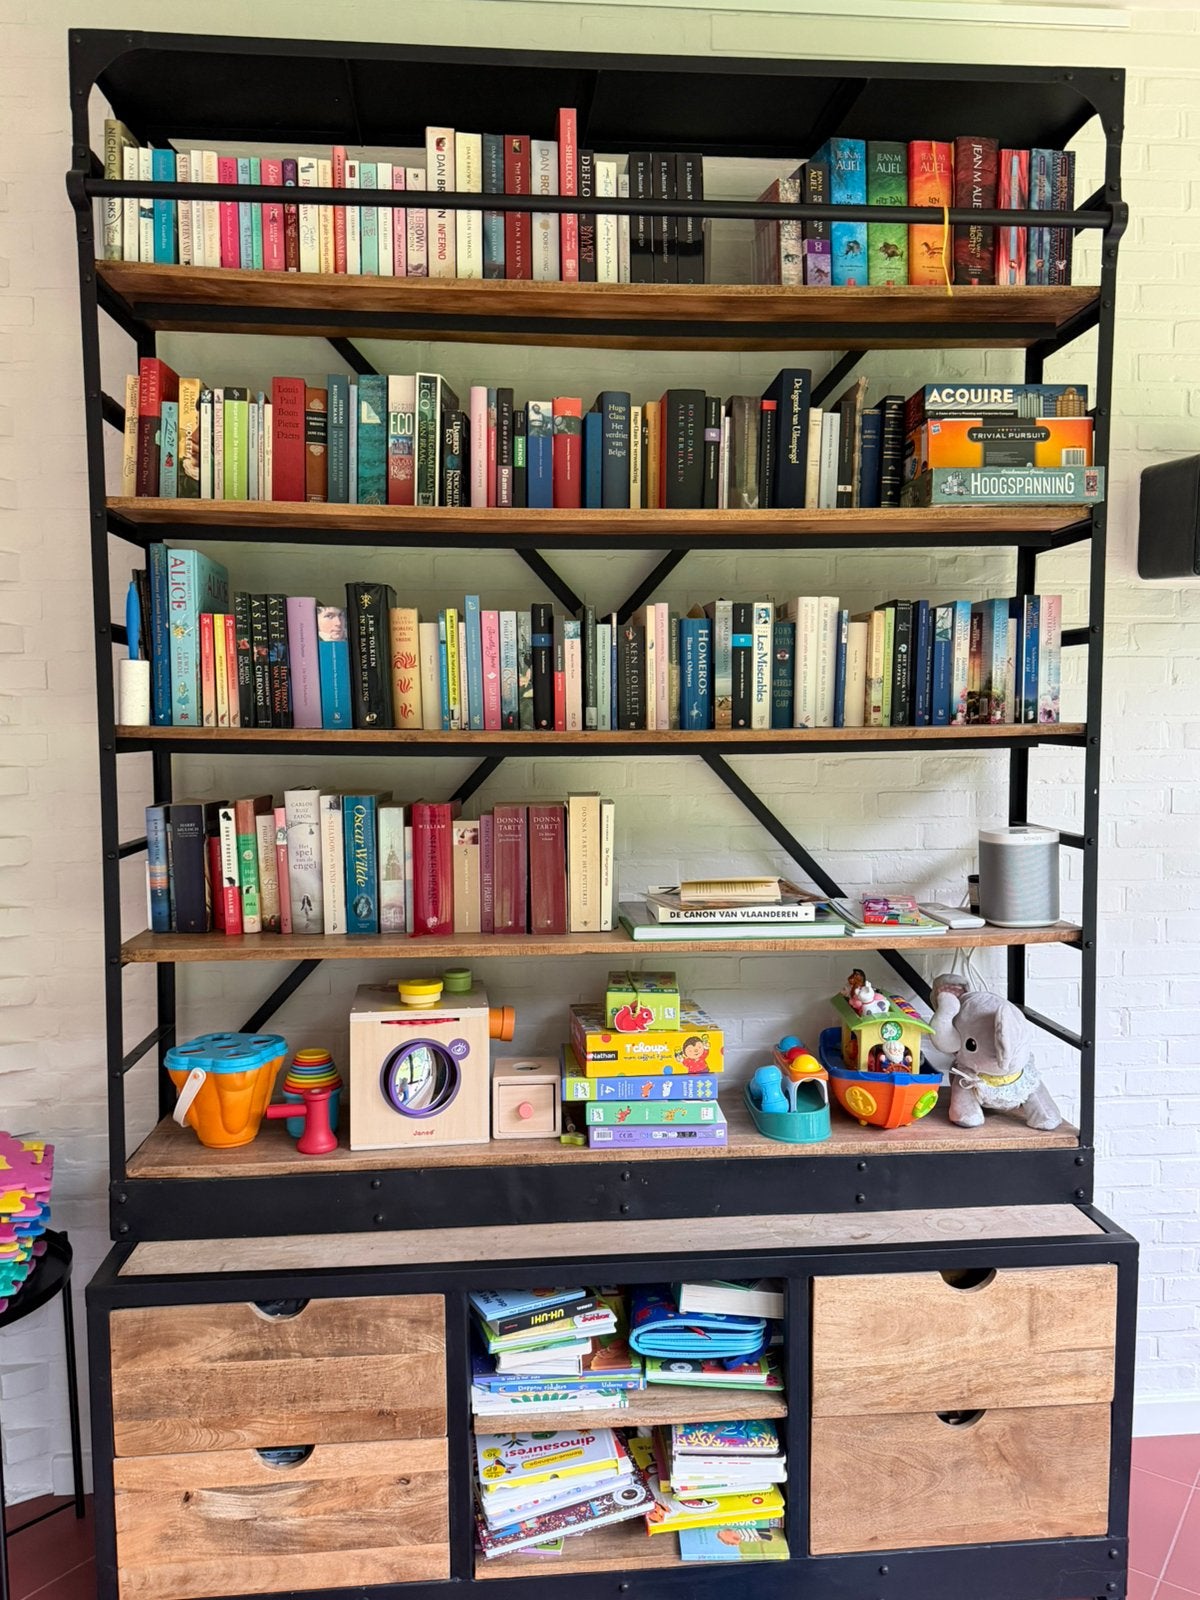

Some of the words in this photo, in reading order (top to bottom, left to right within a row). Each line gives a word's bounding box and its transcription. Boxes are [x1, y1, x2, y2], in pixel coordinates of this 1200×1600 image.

[437, 154, 446, 176] DAN
[540, 148, 549, 171] DAN
[565, 144, 573, 189] SHERLOCK
[835, 161, 862, 172] AUEL
[876, 162, 902, 174] AUEL
[973, 144, 982, 169] JEAN
[582, 155, 591, 197] DEFLO
[974, 170, 982, 182] M
[416, 216, 424, 252] BROWN
[438, 223, 446, 260] INFERNO
[278, 385, 299, 394] Louis
[794, 378, 802, 388] De
[280, 396, 296, 404] Paul
[420, 382, 430, 410] ECO
[790, 389, 800, 414] legende
[928, 388, 1014, 403] ACQUIRE
[278, 408, 298, 416] Boon
[608, 404, 626, 412] Hugo
[278, 420, 300, 430] Pieter
[390, 412, 413, 435] ECO
[789, 426, 800, 464] Uilenspiegel
[971, 472, 1074, 495] HOOGSPANNING
[252, 599, 261, 641] ASPE
[270, 598, 280, 639] ASPE
[360, 626, 366, 635] DE
[757, 634, 768, 650] Les
[631, 642, 639, 664] KEN
[688, 652, 692, 660] en
[698, 630, 708, 695] HOMEROS
[256, 664, 264, 706] CHRONOS
[362, 671, 368, 680] DE
[632, 669, 640, 717] FOLLETT
[328, 821, 336, 851] SHADOW
[354, 805, 367, 848] Oscar
[296, 848, 314, 858] spel
[293, 861, 318, 872] engel
[356, 848, 368, 888] Wilde
[428, 835, 438, 906] SHAKESPEARE
